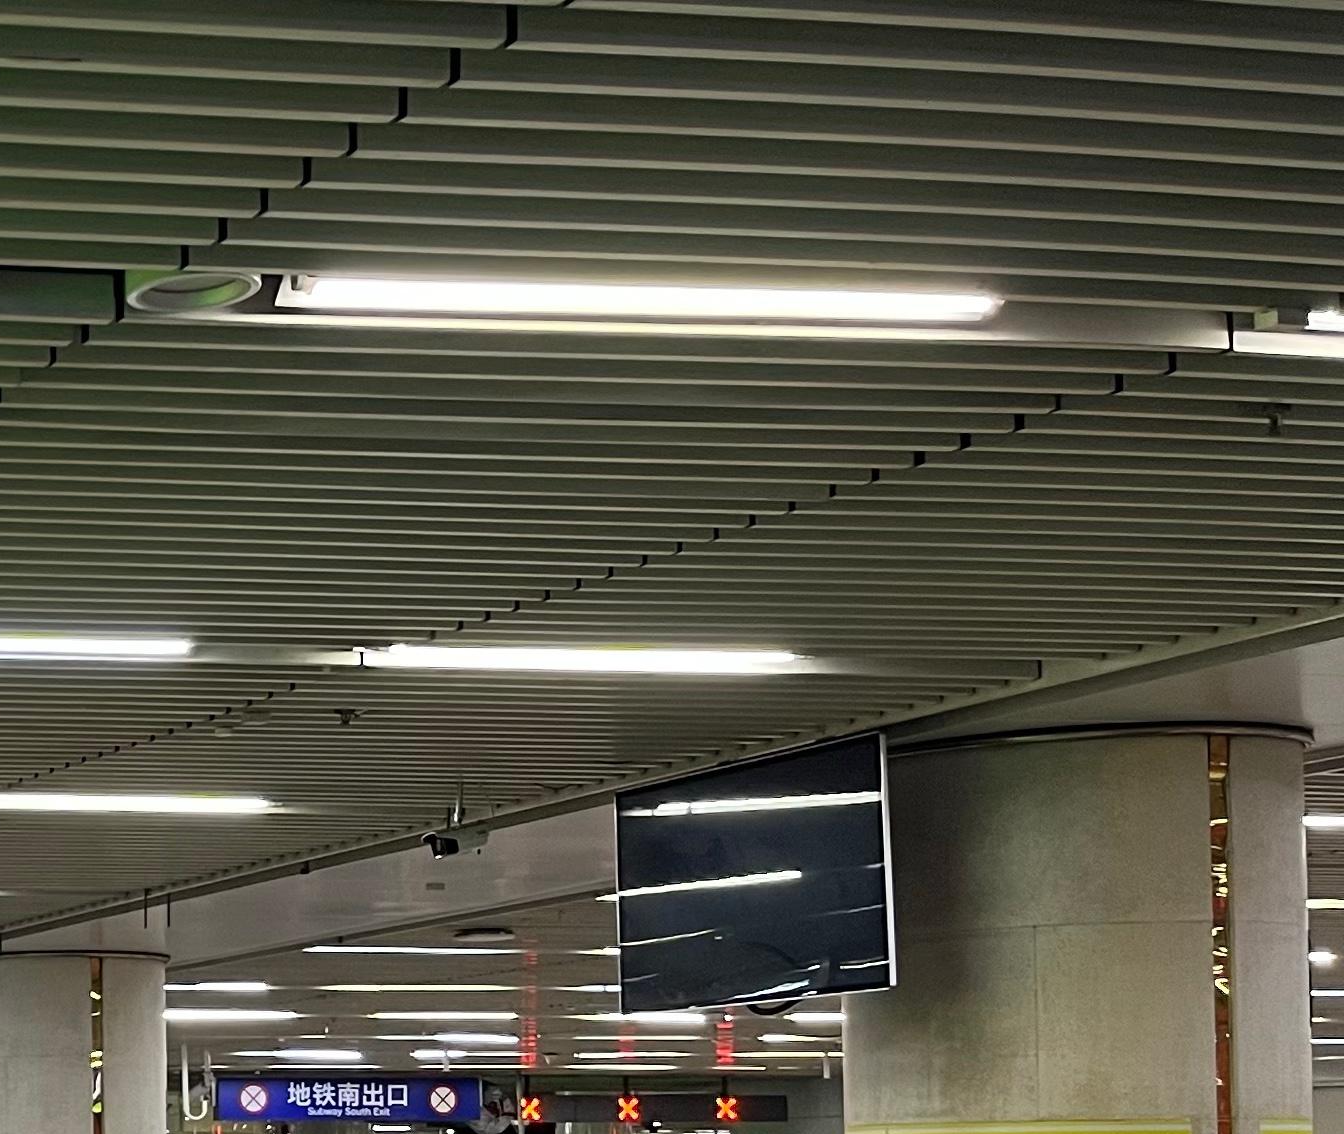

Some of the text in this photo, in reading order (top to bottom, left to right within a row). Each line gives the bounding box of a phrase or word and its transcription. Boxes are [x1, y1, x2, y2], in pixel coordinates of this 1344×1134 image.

[288, 1082, 408, 1107] 地铁南出口
[307, 1107, 391, 1117] Subway South Exit
